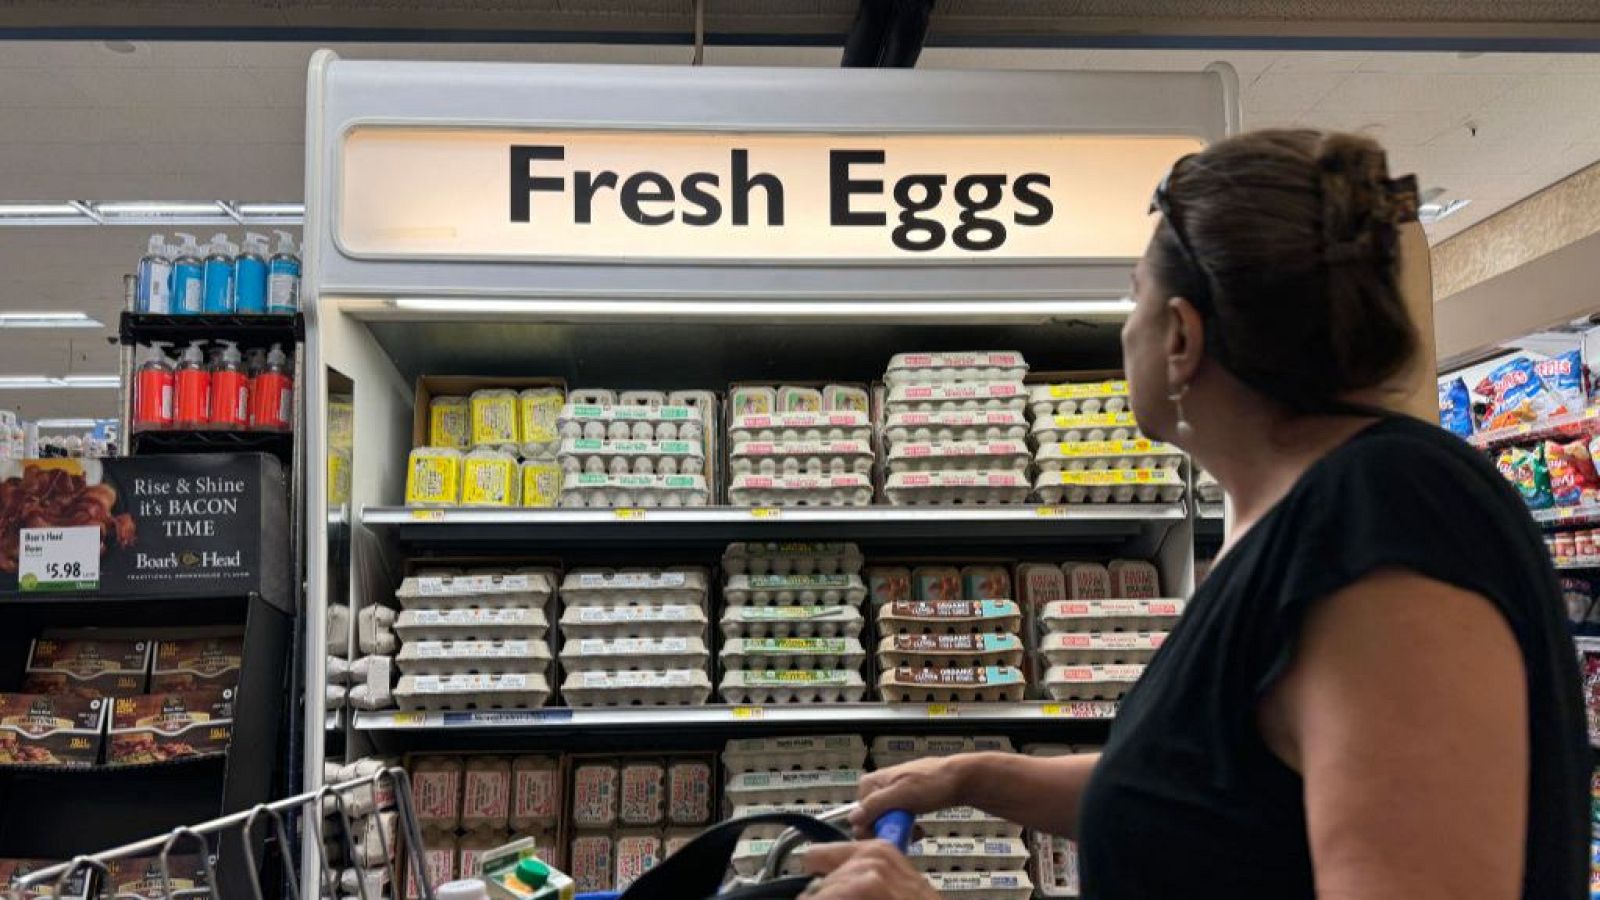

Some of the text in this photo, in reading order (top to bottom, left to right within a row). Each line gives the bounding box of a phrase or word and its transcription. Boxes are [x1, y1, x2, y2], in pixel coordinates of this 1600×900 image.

[510, 145, 1054, 251] Fresh Eggs
[135, 476, 245, 495] Rise & Shine
[141, 498, 237, 517] it's BACON
[162, 519, 215, 537] TIME
[136, 549, 240, 569] Boar's Head
